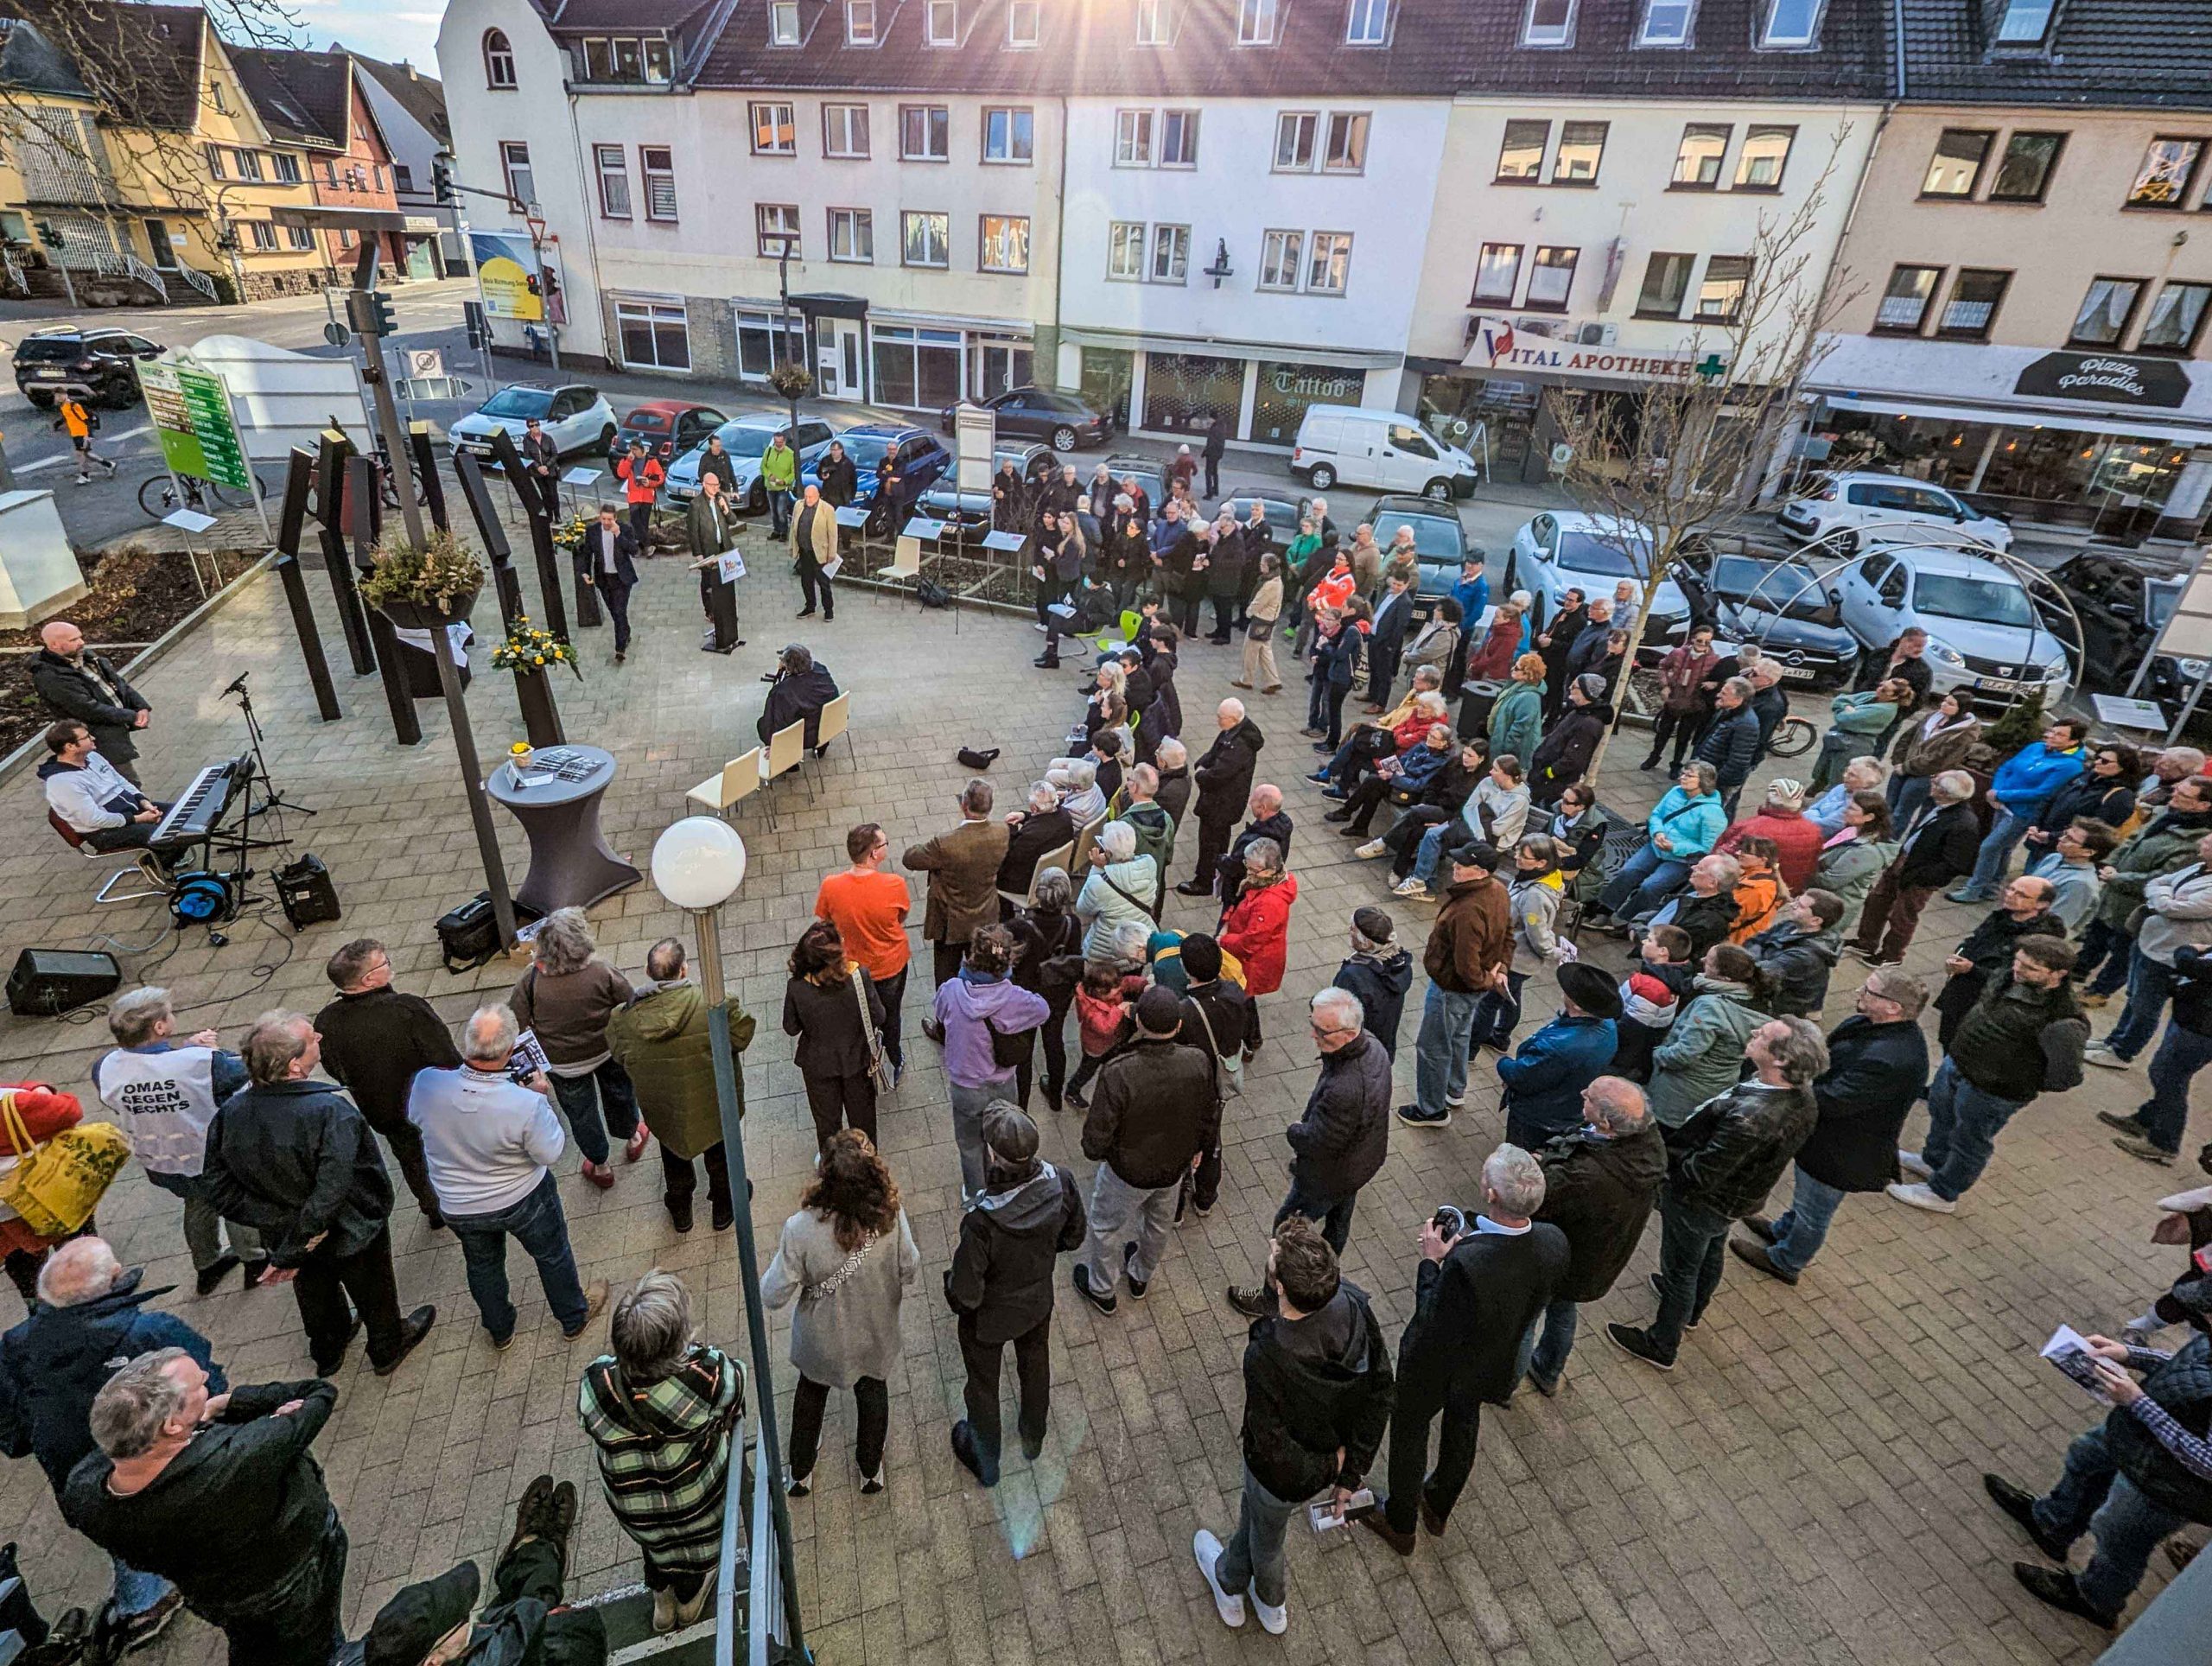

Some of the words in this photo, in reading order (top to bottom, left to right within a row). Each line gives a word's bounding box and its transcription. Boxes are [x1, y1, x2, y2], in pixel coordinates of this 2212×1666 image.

[1483, 321, 1562, 369] VITAL
[1567, 352, 1693, 378] APOTHEKE
[2079, 357, 2140, 378] Pizza
[1274, 371, 1346, 397] Tattoo
[2058, 372, 2145, 396] Paradies
[124, 1079, 175, 1094] OMAS
